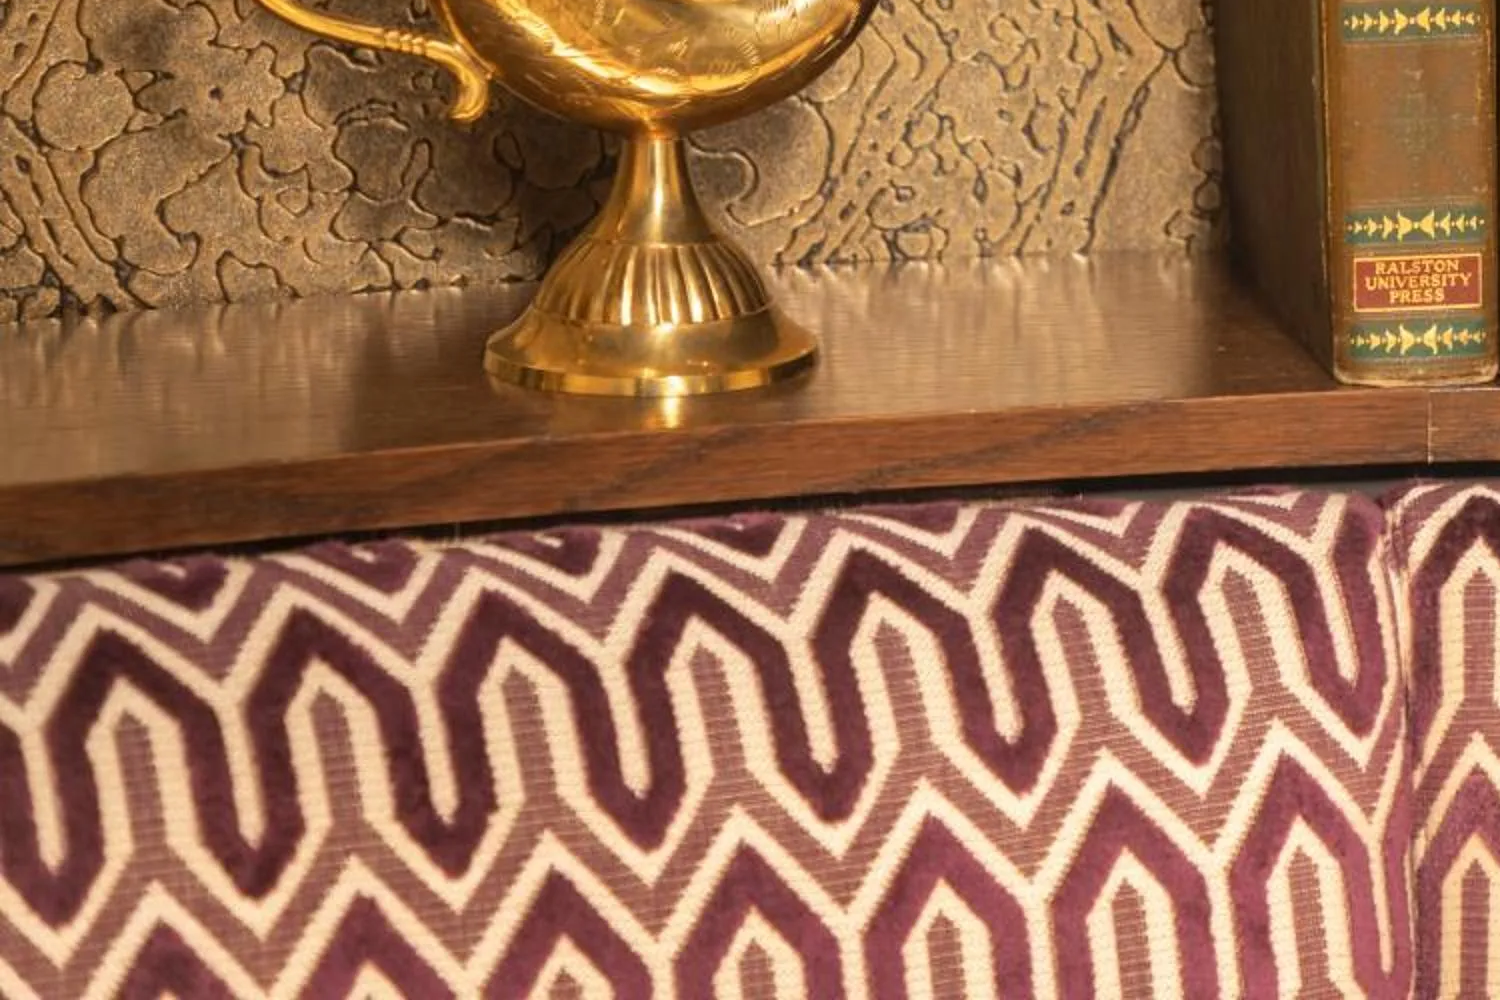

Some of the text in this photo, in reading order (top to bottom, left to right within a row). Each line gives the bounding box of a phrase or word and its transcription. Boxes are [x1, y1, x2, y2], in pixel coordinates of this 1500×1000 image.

[1375, 259, 1460, 275] RALSTON
[1365, 273, 1472, 290] UNIVERSITY
[1389, 288, 1445, 304] PRESS
